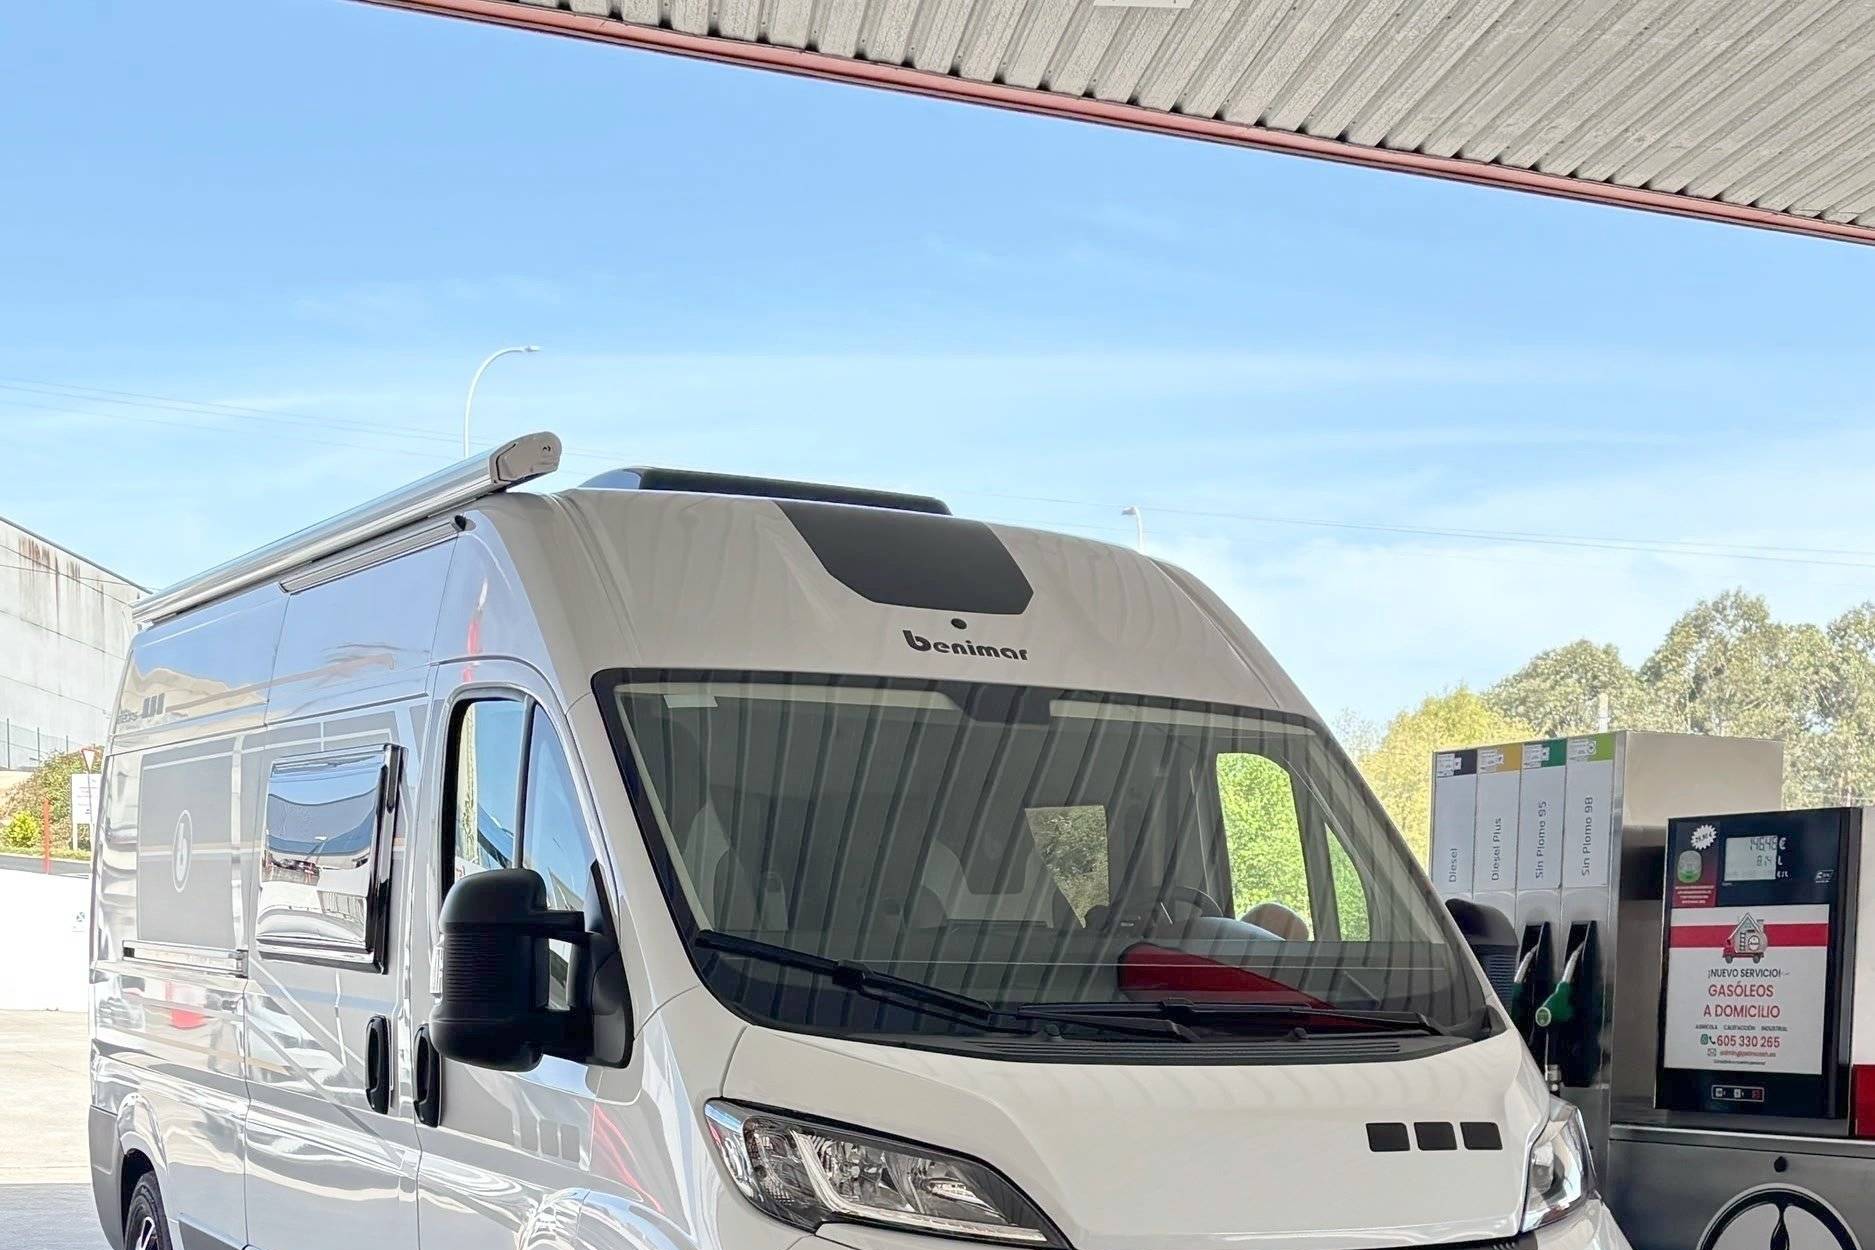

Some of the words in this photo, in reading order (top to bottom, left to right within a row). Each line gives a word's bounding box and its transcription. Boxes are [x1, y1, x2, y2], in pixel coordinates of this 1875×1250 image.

[902, 630, 1028, 660] benimar
[1538, 801, 1546, 816] 95
[1585, 797, 1593, 812] 98
[1493, 818, 1501, 842] Plus
[1536, 820, 1546, 857] Plomo
[1582, 818, 1593, 854] Plomo
[1449, 848, 1458, 883] Diesel
[1491, 847, 1500, 881] Diesel
[1535, 861, 1545, 879] Sin
[1581, 858, 1590, 876] Sin
[1740, 969, 1781, 978] SERVICIO!
[1708, 981, 1774, 998] GASÓLEOS
[1703, 1005, 1712, 1018] A
[1715, 1005, 1781, 1019] DOMICILIO
[1716, 1035, 1737, 1047] 605
[1738, 1036, 1758, 1048] 330
[1760, 1036, 1780, 1049] 265
